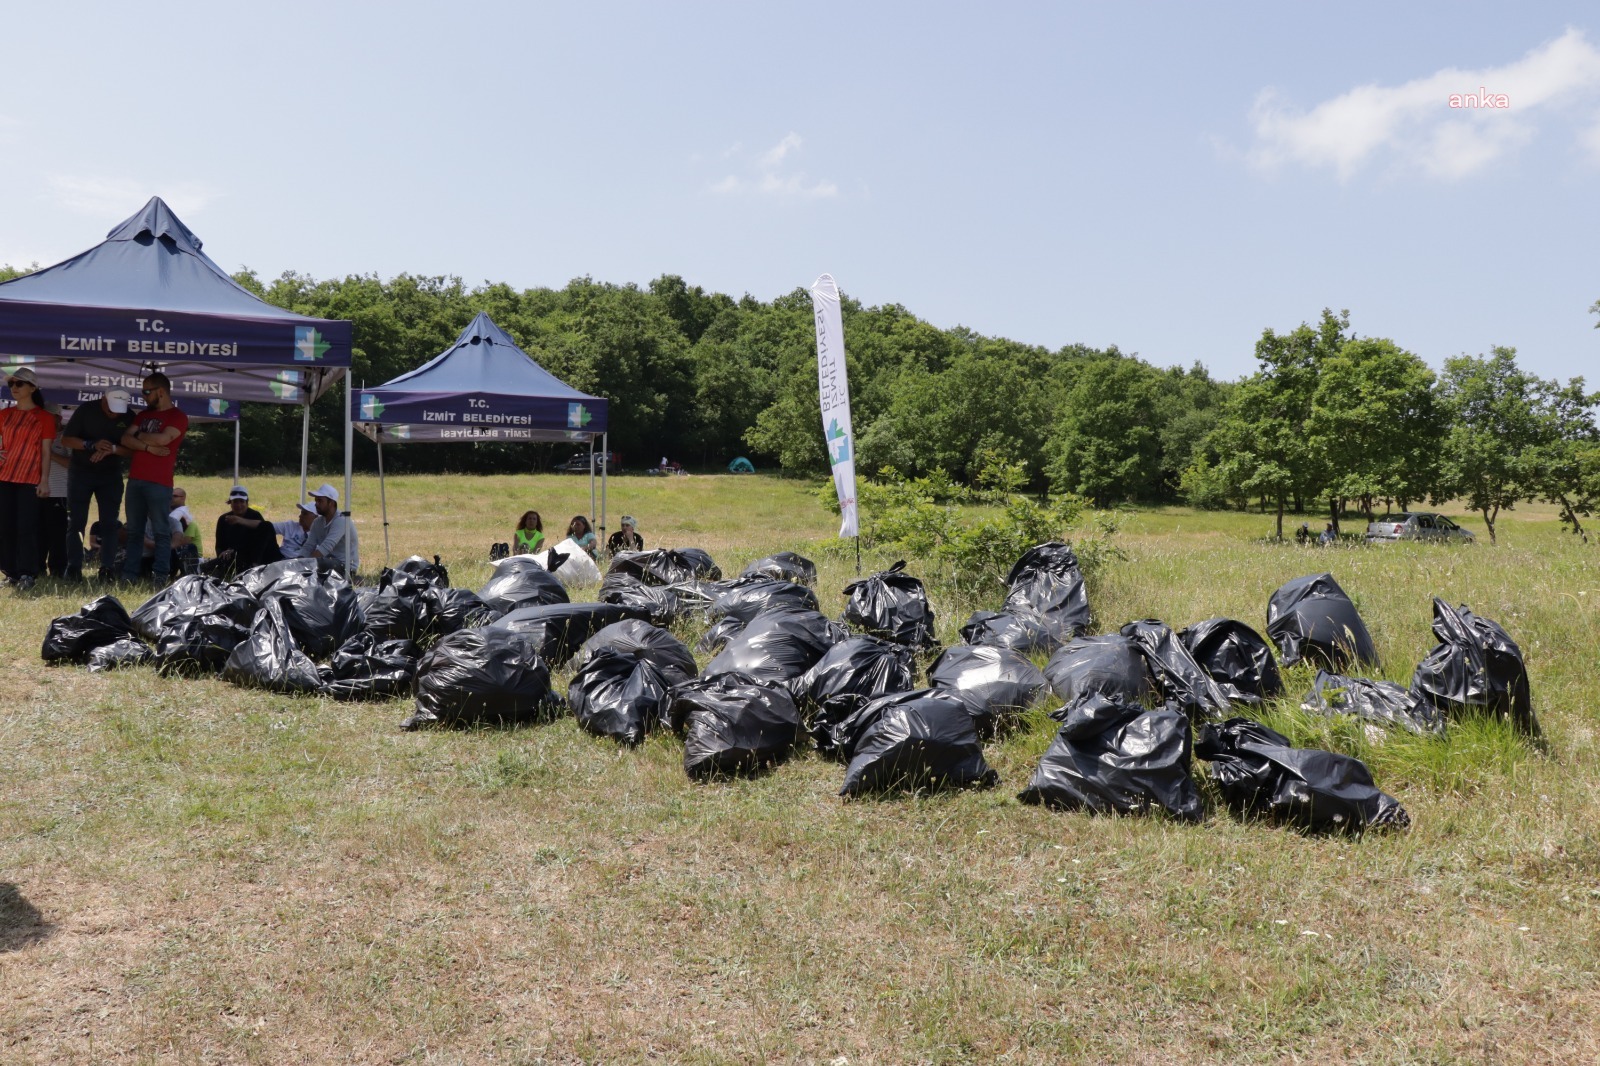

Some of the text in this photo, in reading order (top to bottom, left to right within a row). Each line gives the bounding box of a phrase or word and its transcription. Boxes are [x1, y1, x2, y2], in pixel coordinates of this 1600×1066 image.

[136, 318, 170, 333] T.C.
[60, 334, 238, 357] İZMİT BELEDİYESİ
[77, 390, 105, 402] İZMİ
[468, 398, 490, 409] T.C.
[422, 410, 532, 425] İZMİT BELEDİYESİ
